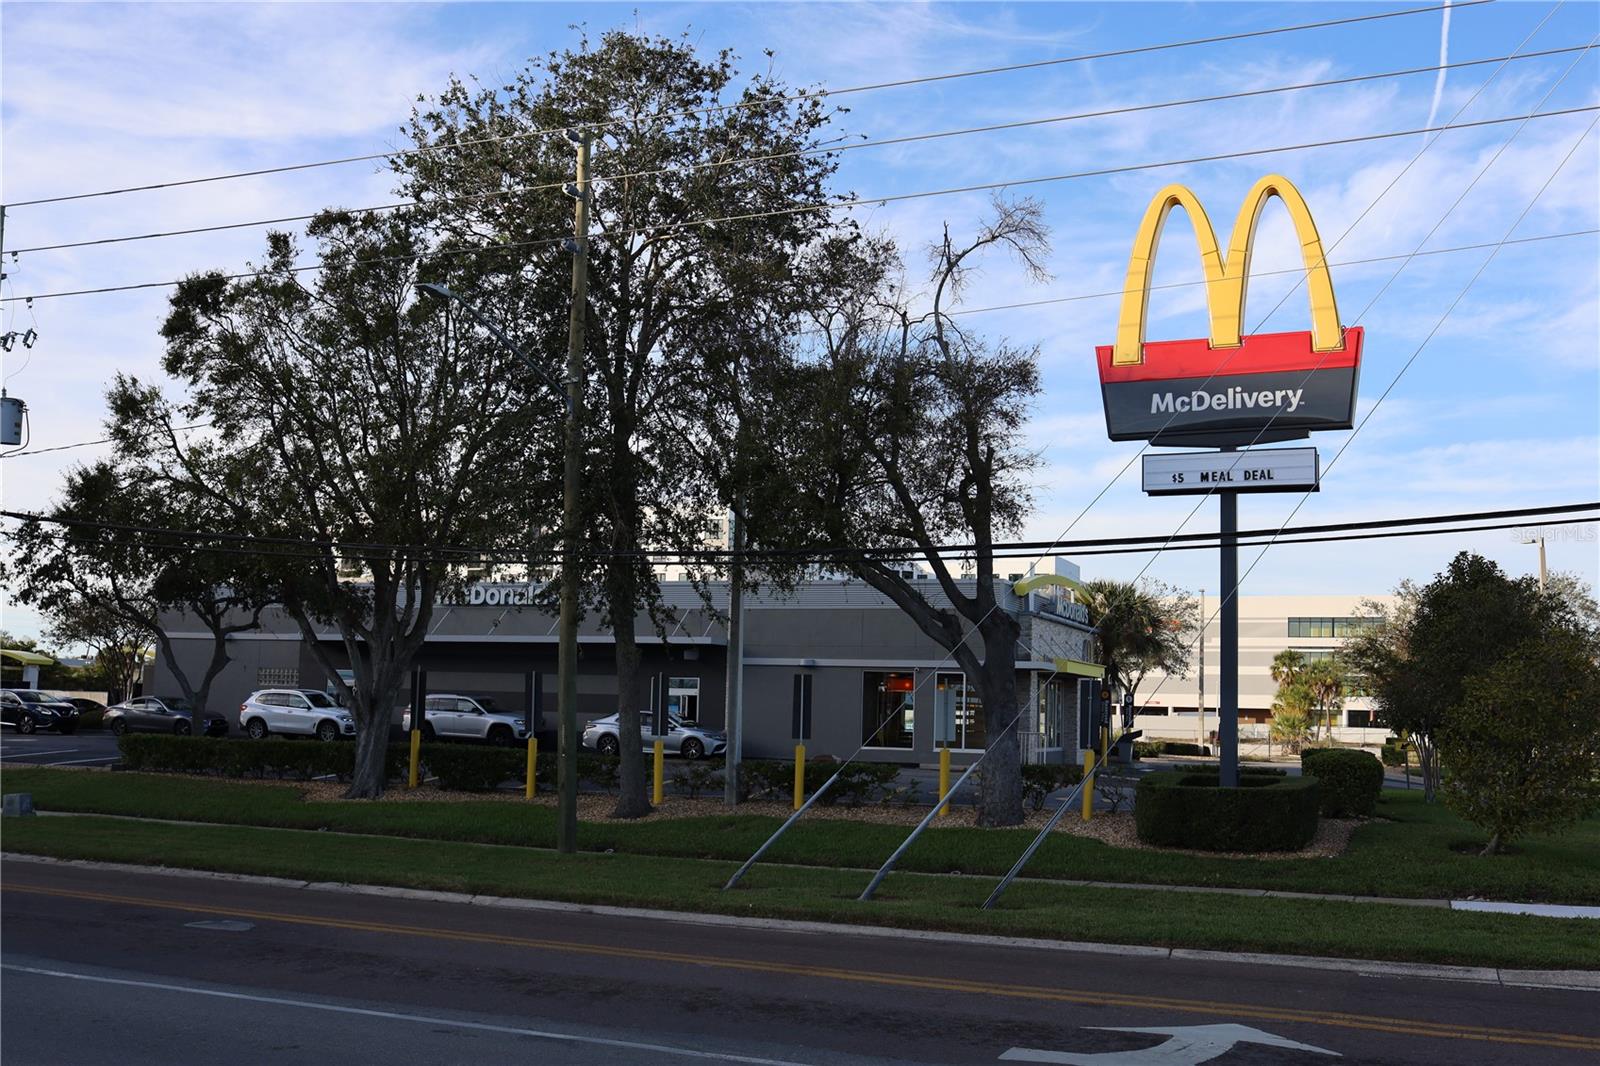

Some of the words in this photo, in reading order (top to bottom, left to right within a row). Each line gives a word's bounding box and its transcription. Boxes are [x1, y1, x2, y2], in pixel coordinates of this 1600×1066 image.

[1150, 386, 1303, 414] McDelivery
[1172, 473, 1184, 483] $5
[1200, 471, 1234, 483] MEAL
[1243, 469, 1274, 481] DEAL
